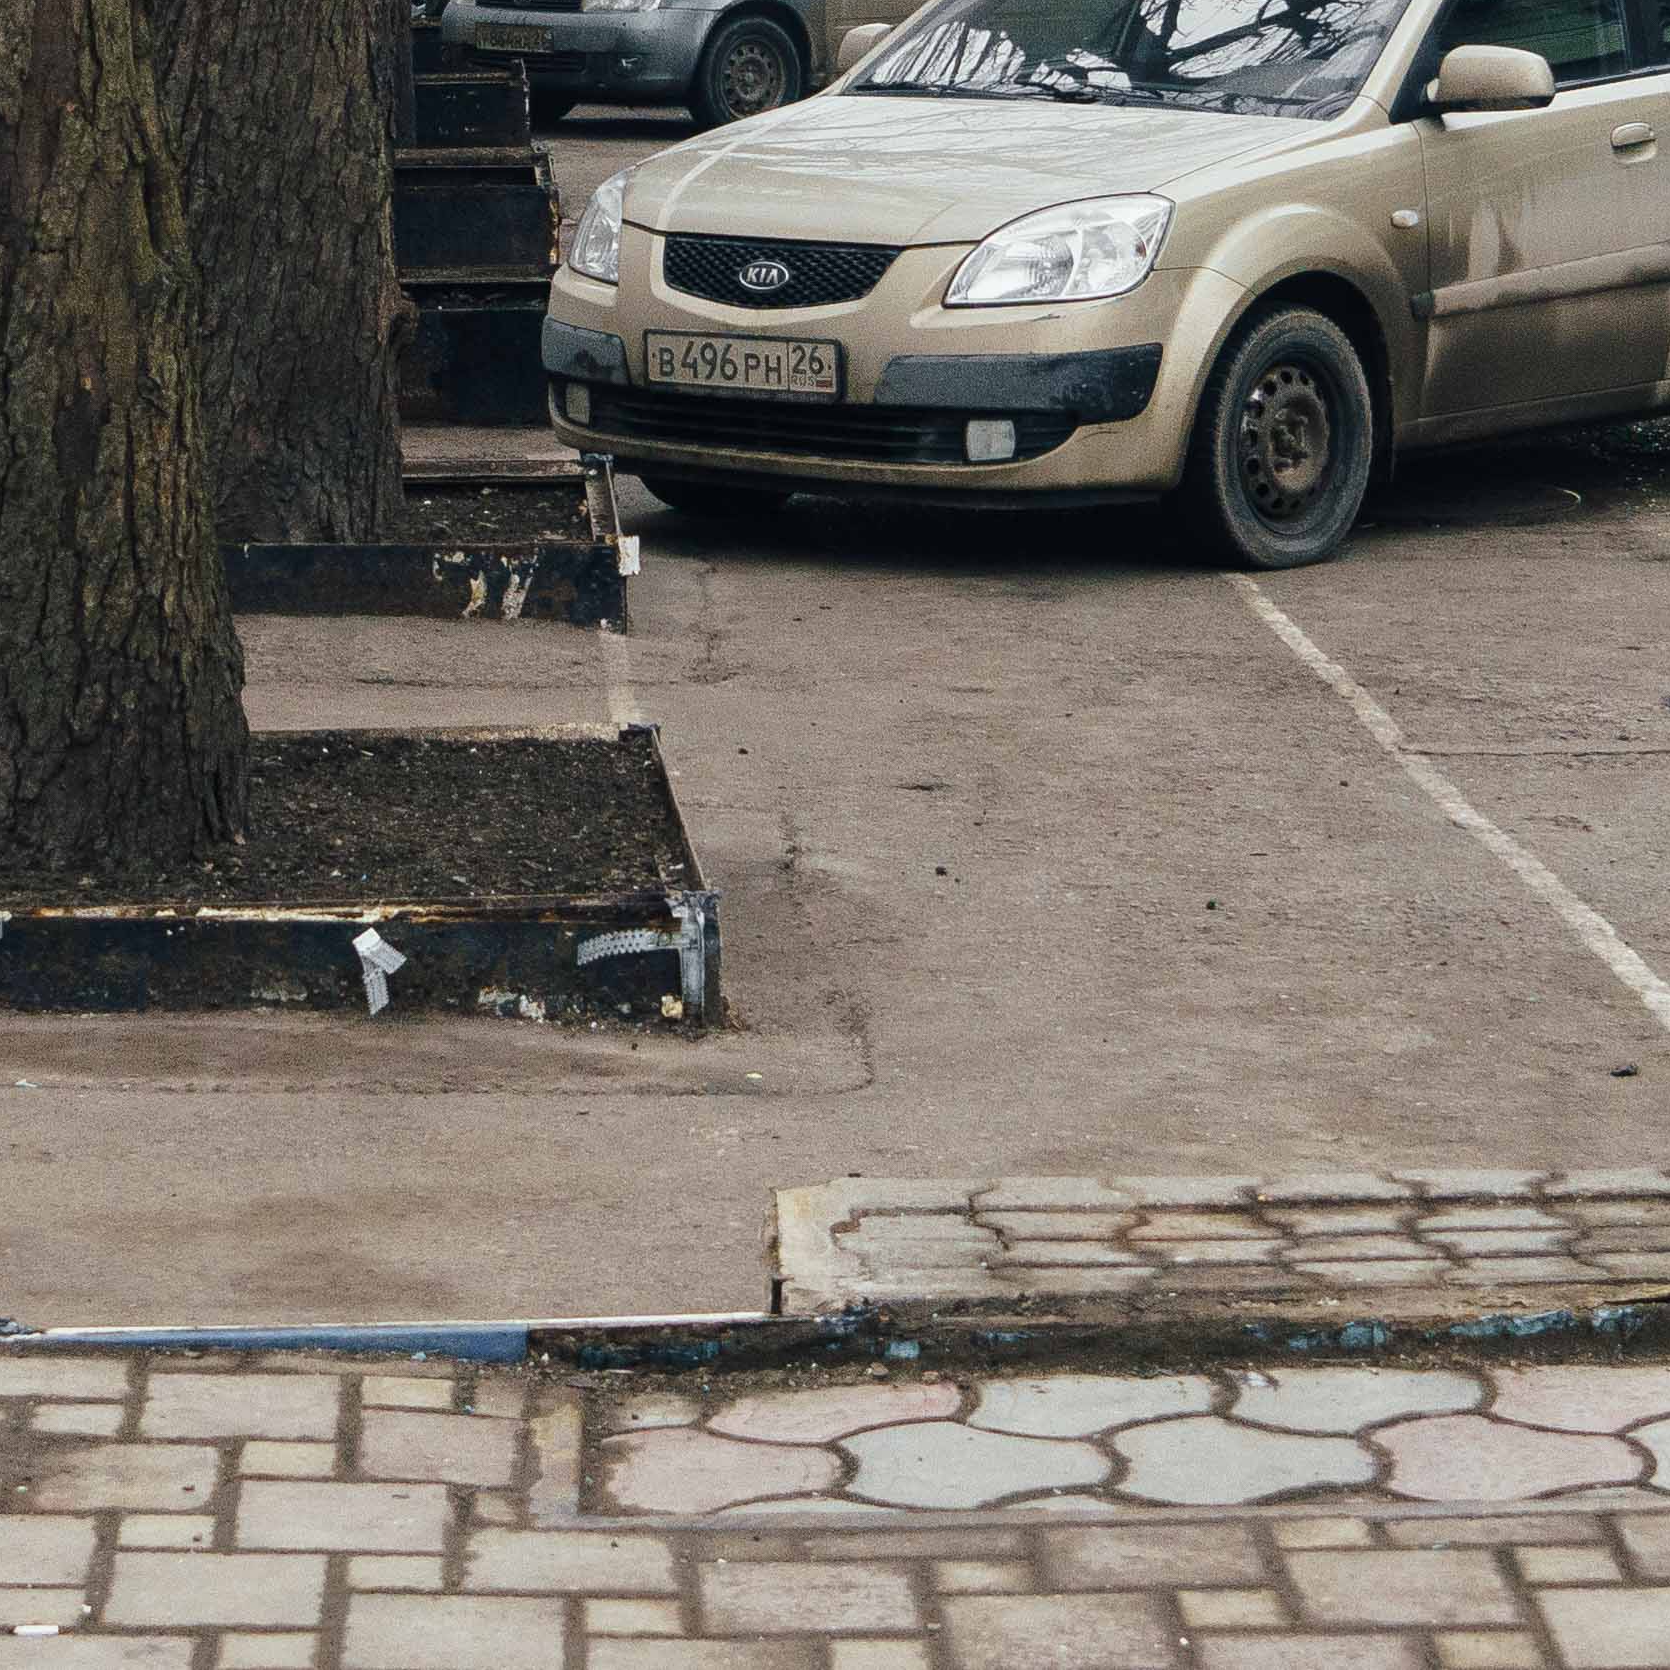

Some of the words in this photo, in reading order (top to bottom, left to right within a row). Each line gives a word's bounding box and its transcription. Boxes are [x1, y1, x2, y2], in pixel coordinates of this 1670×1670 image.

[746, 267, 779, 284] KIA
[658, 340, 781, 384] В496РН
[791, 344, 825, 375] 26
